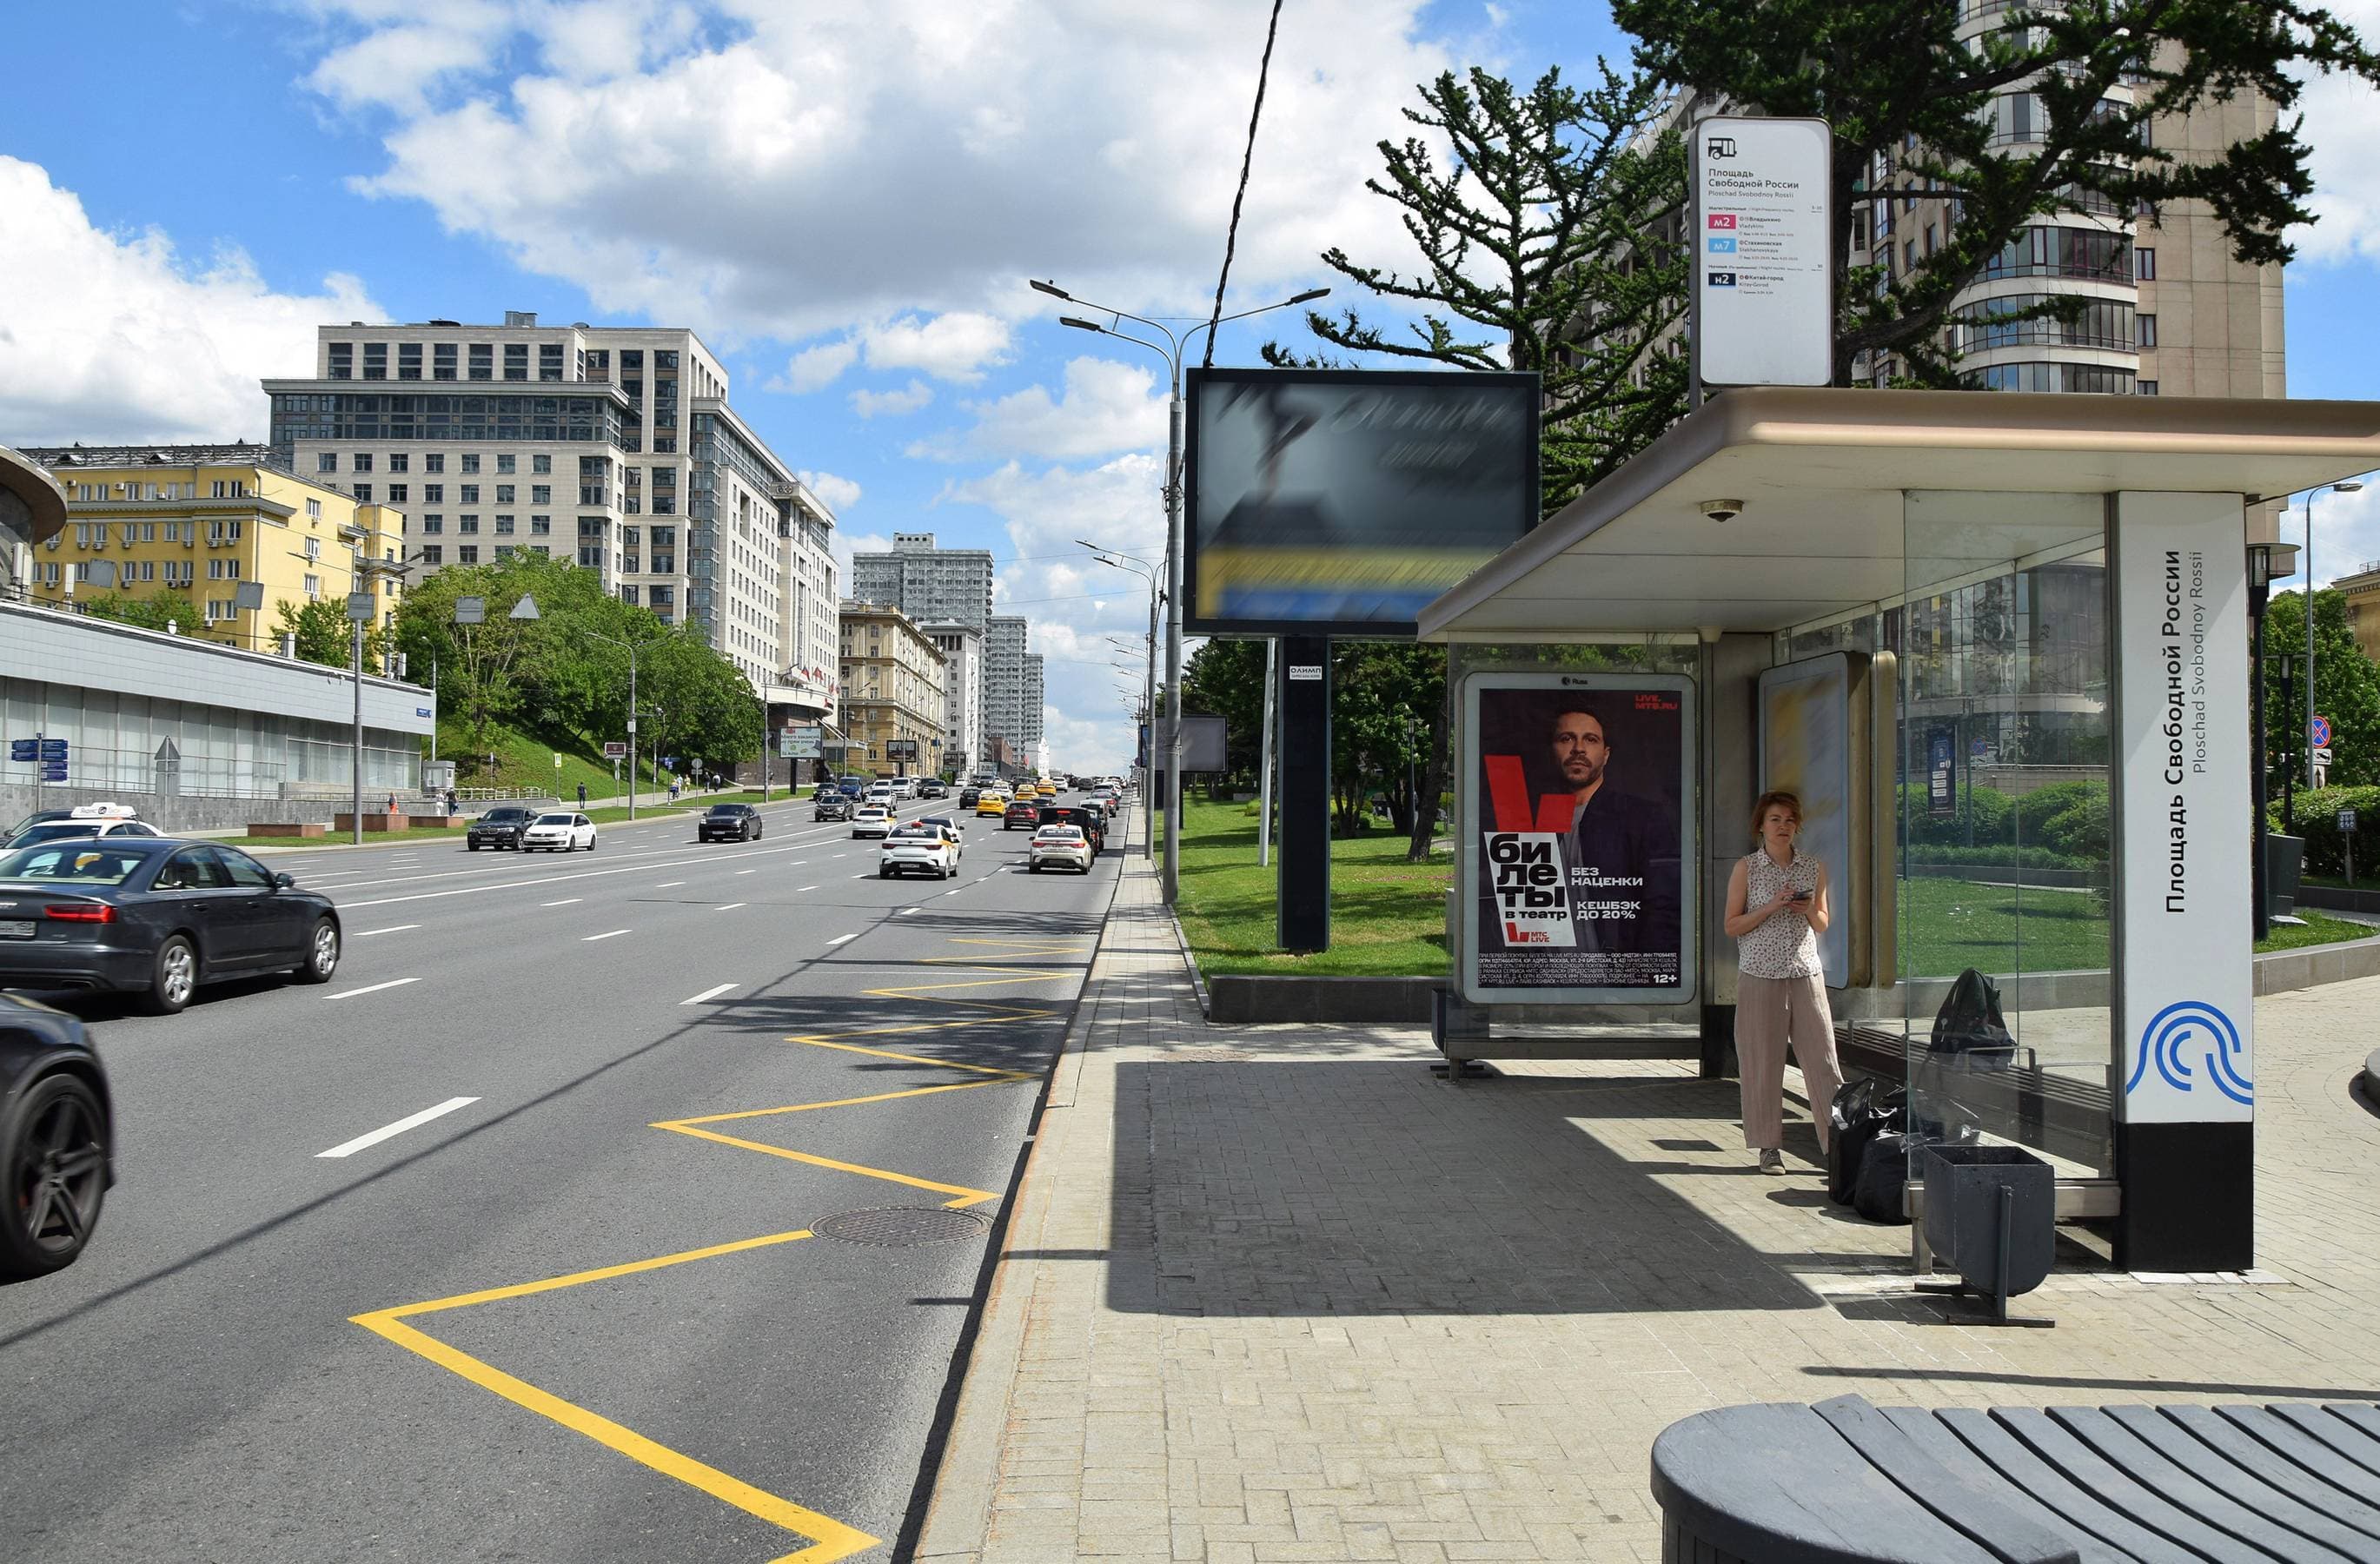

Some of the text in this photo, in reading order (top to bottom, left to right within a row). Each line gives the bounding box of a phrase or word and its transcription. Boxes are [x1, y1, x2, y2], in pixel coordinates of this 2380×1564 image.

[1708, 168, 1754, 177] Площадь
[1708, 178, 1800, 189] Свободной России
[2189, 552, 2206, 773] Ploschad Svobodnoy Rossii
[2162, 551, 2187, 912] Площадь Свободной России
[1489, 833, 1551, 864] би
[1497, 864, 1558, 886] ле
[1571, 866, 1599, 876] БЕЗ
[1571, 877, 1643, 887] НАЦЕНКИ
[1496, 886, 1565, 907] ты
[1577, 901, 1641, 910] КЕШБЭК
[1519, 911, 1568, 921] театр
[1576, 910, 1636, 920] ДО 20%
[1653, 974, 1677, 984] 12+
